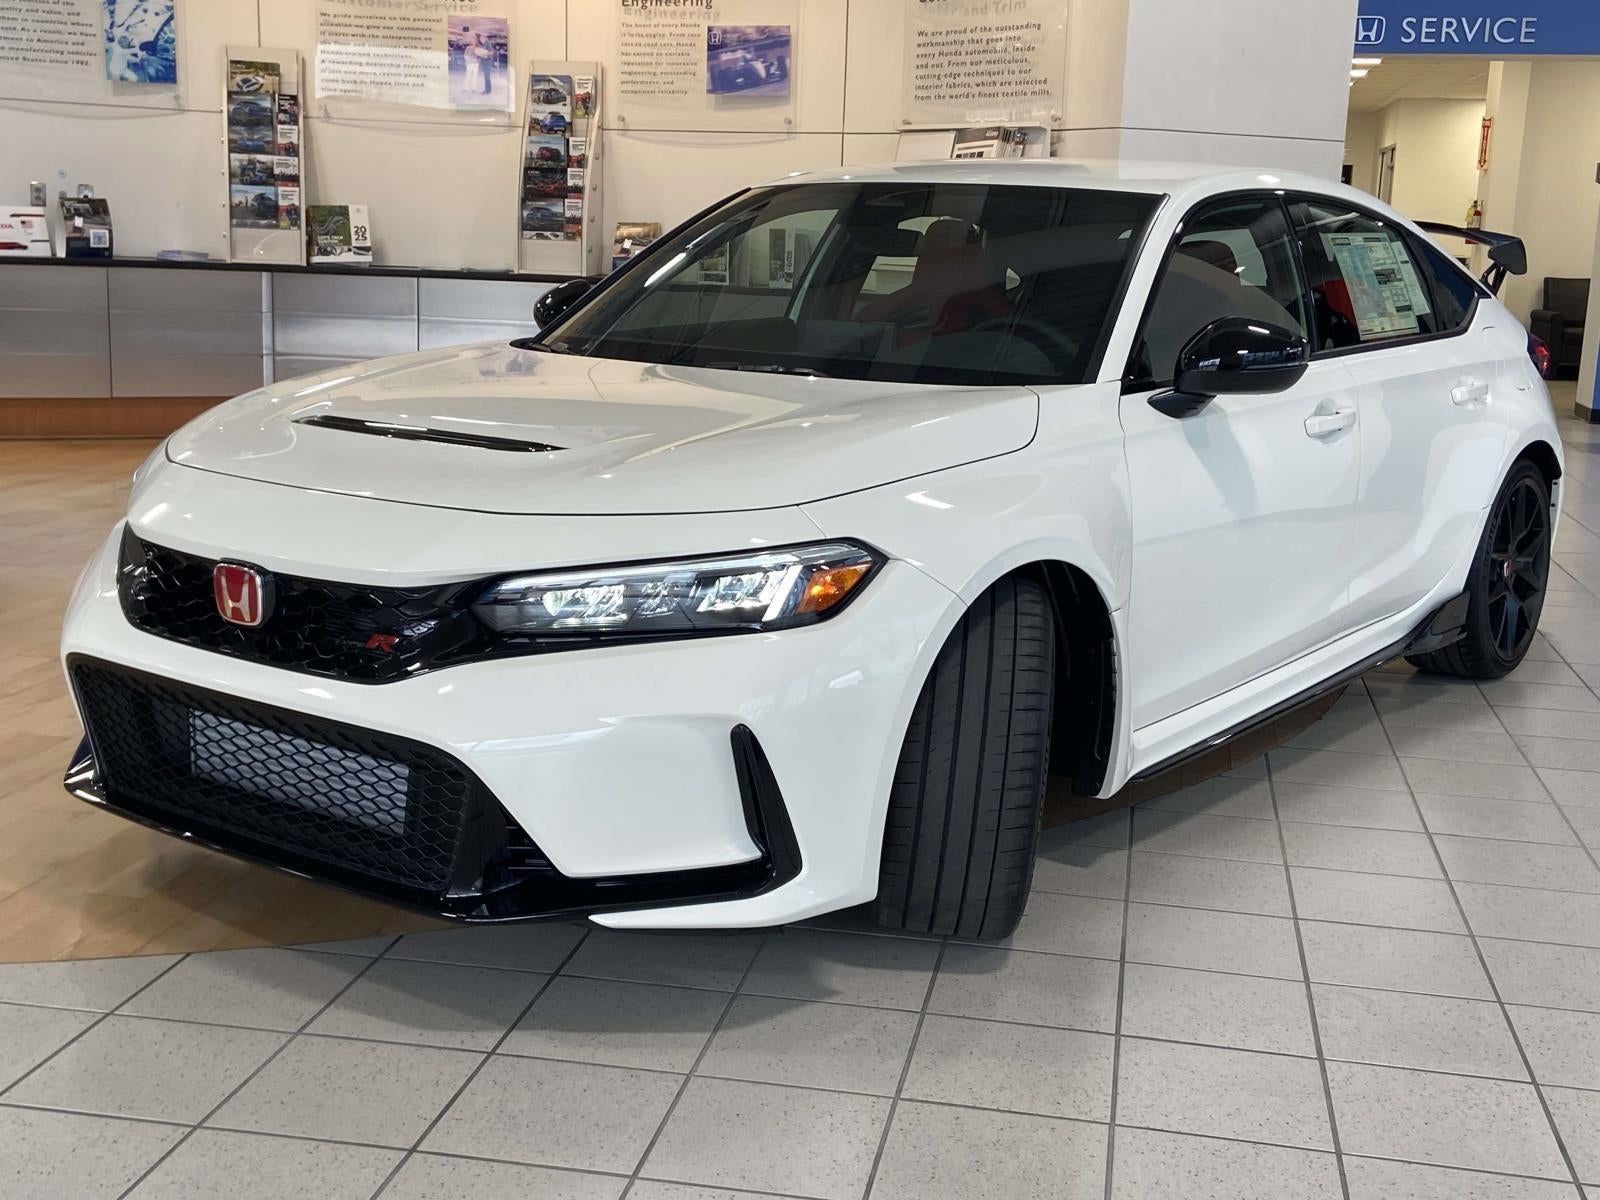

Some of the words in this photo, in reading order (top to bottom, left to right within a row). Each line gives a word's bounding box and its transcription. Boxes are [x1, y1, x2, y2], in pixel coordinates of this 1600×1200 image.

[621, 0, 713, 10] Engineering
[945, 28, 968, 37] proud
[970, 26, 978, 34] of
[994, 22, 1042, 31] outstanding
[1400, 17, 1537, 43] SERVICE
[916, 39, 965, 48] workmanship
[916, 52, 936, 60] every
[938, 50, 962, 58] Honda
[915, 62, 929, 70] and
[947, 60, 967, 68] From
[915, 72, 961, 81] cutting-edge
[963, 68, 1005, 78] techniques
[914, 83, 943, 91] interior
[975, 80, 997, 88] which
[1014, 77, 1048, 86] selected
[1002, 90, 1028, 98] textile
[353, 225, 367, 234] 20
[354, 233, 368, 241] 25
[367, 632, 398, 653] R
